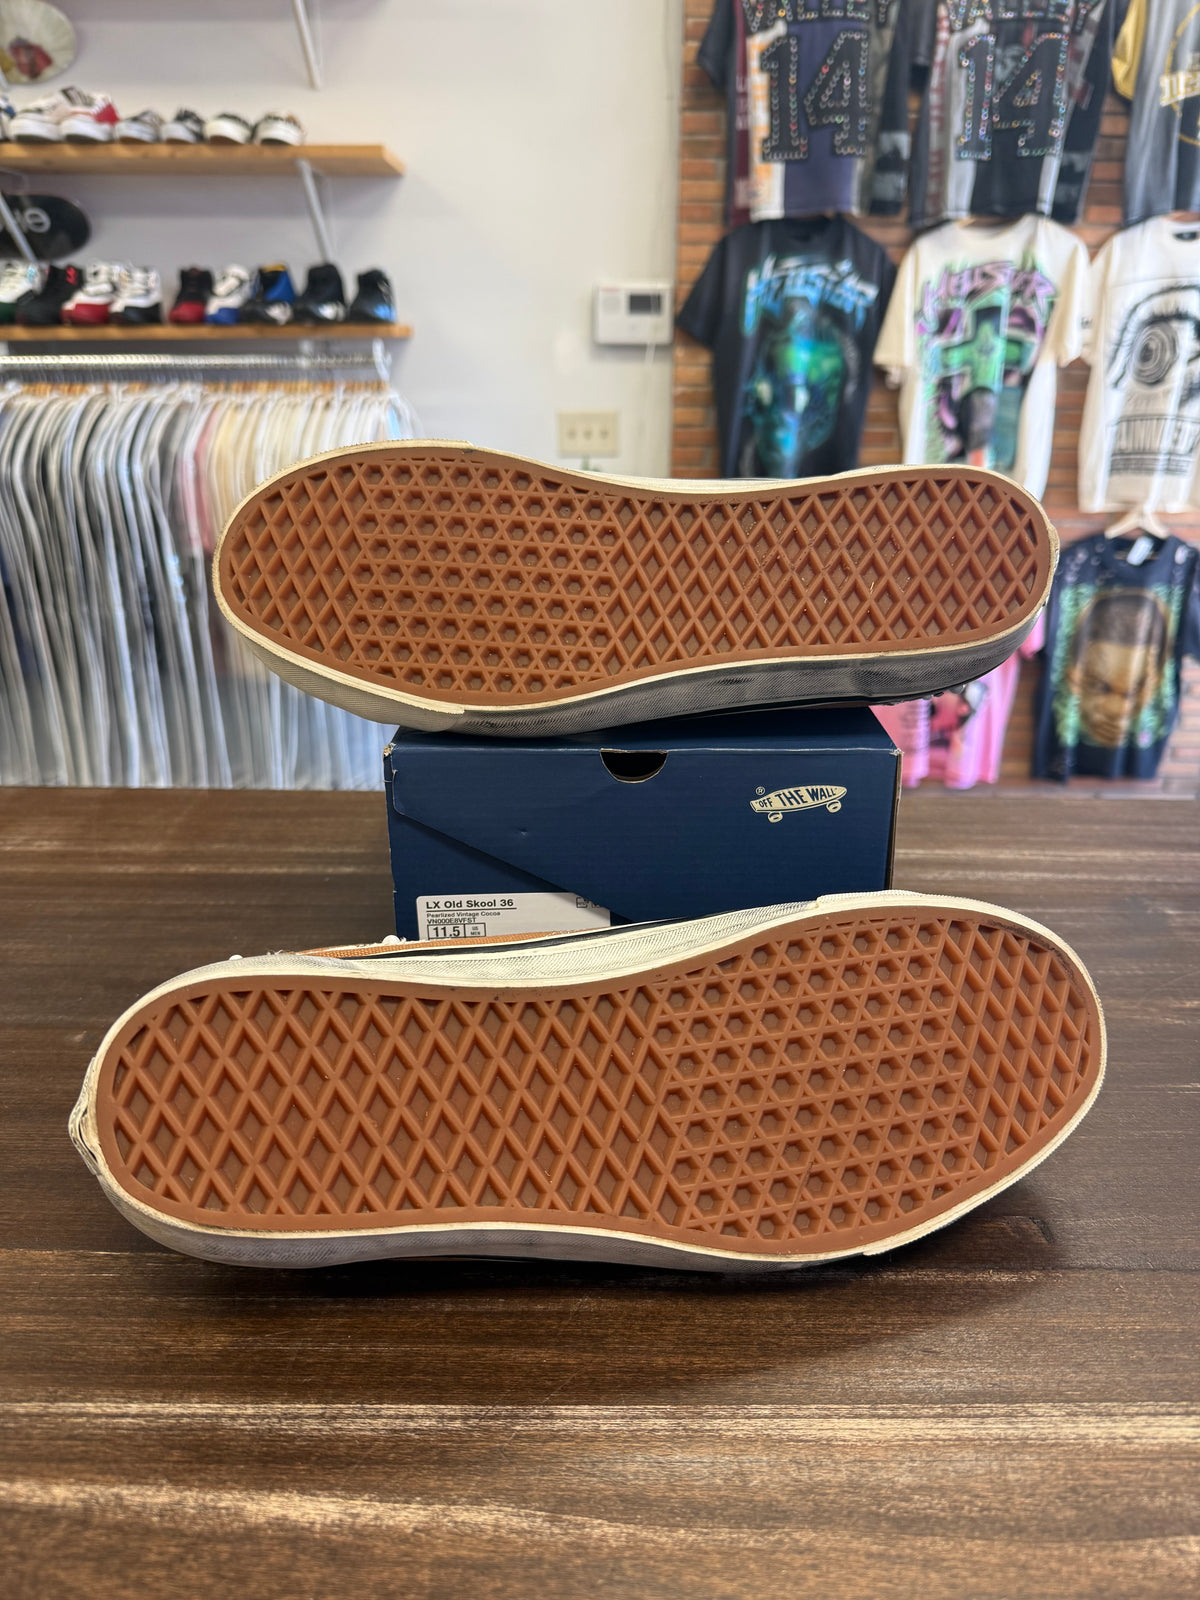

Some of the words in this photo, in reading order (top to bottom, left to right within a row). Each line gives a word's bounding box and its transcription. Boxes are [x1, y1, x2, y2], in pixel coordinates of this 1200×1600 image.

[758, 797, 774, 809] OFF
[775, 789, 809, 806] THE
[805, 787, 837, 802] WALL
[426, 901, 441, 909] LX
[444, 900, 463, 909] Old
[466, 899, 497, 908] Skool
[500, 898, 514, 907] 36
[433, 926, 460, 938] 11.5
